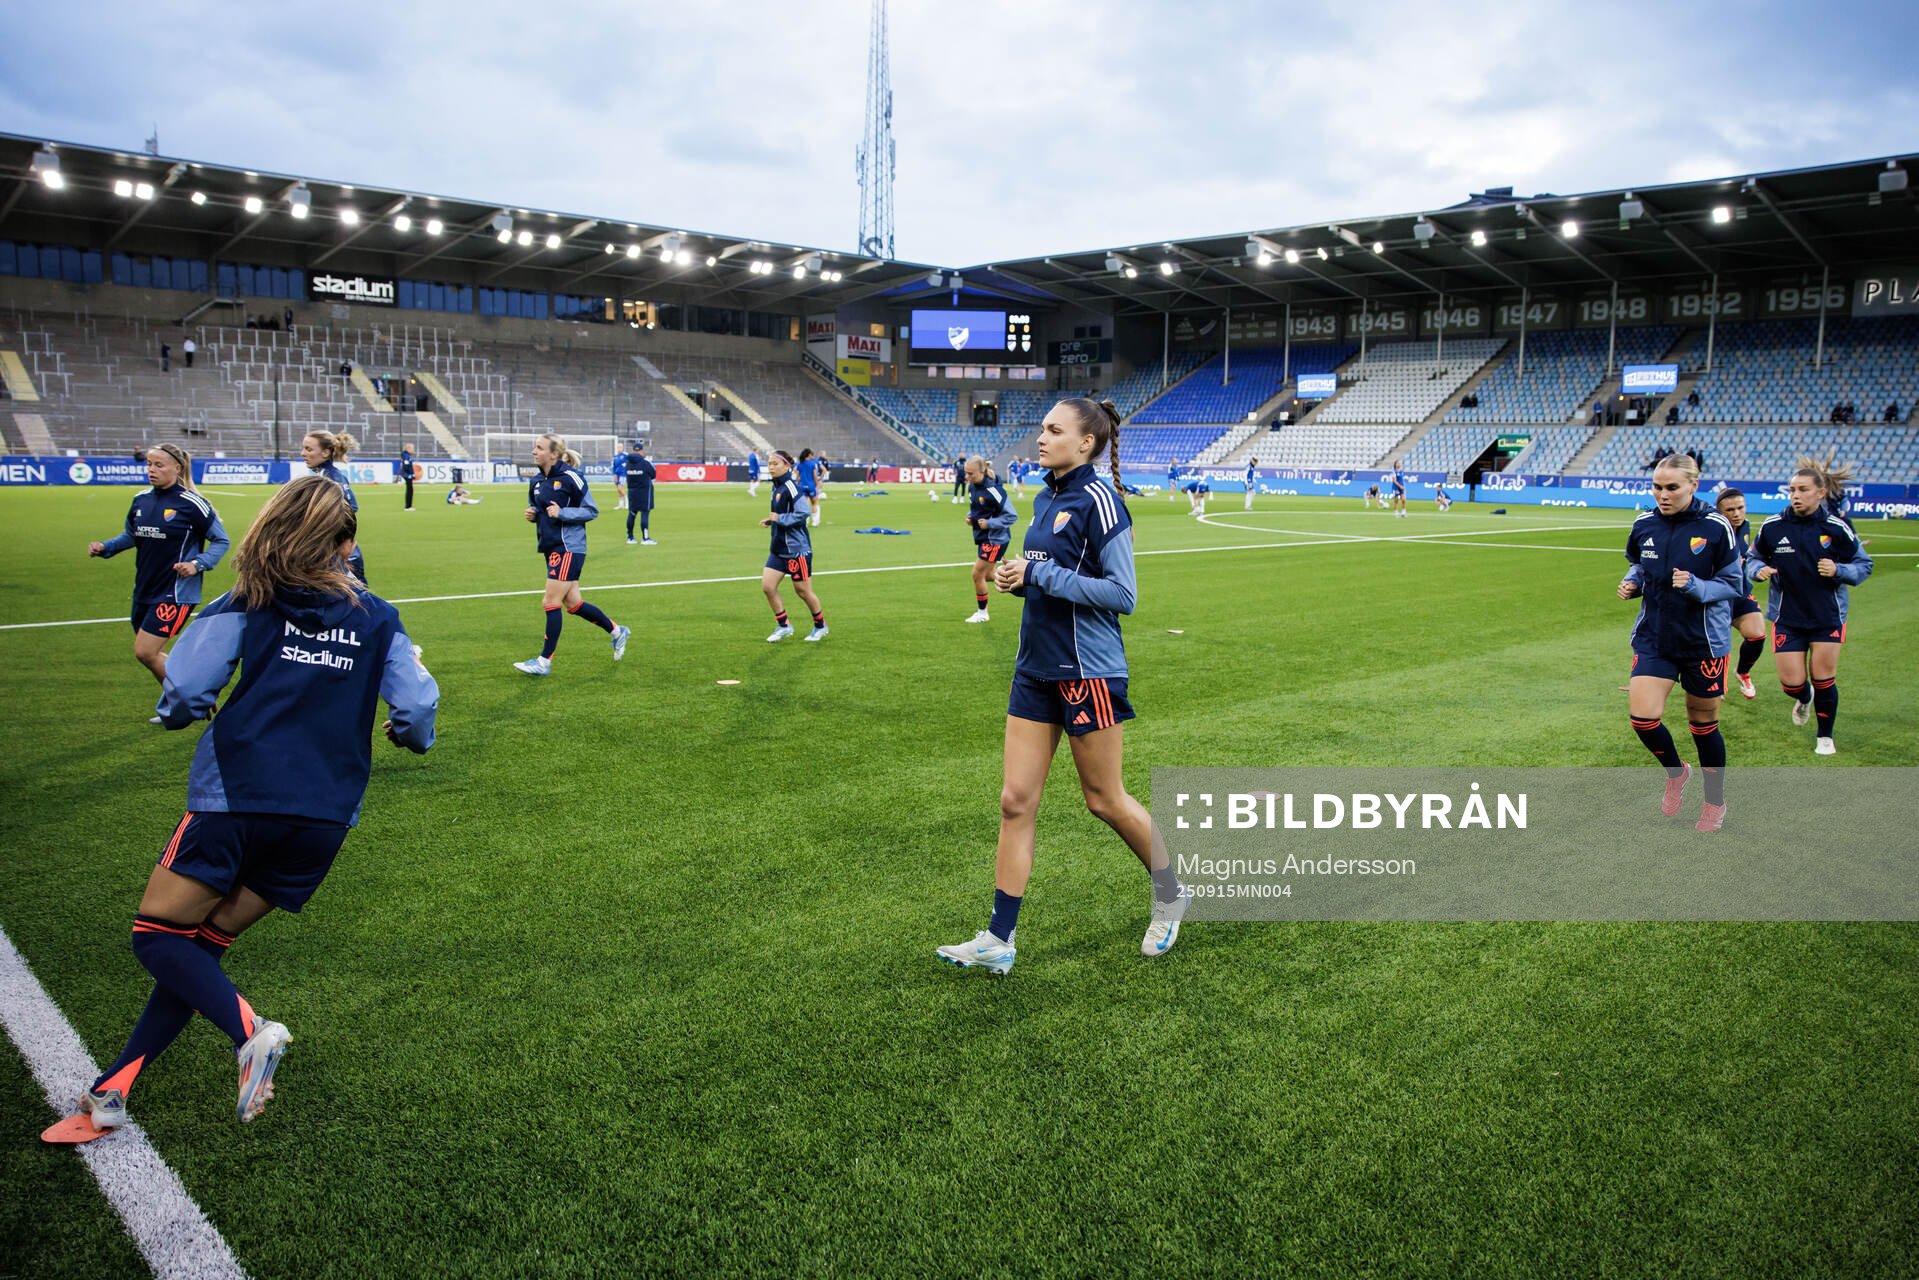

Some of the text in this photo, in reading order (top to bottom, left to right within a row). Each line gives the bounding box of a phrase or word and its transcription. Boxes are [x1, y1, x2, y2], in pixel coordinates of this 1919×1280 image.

[313, 274, 394, 298] stadium
[1580, 297, 1646, 321] 1948
[1670, 291, 1742, 317] 1952
[1765, 285, 1845, 312] 1956
[1349, 311, 1405, 332] 1945
[1424, 307, 1480, 329] 1946
[1500, 303, 1558, 325] 1947
[1288, 316, 1336, 336] 1943
[848, 335, 881, 352] MAXI
[1060, 342, 1081, 352] pre
[1060, 353, 1088, 364] zero
[427, 466, 446, 480] DS
[1581, 479, 1612, 490] EASY
[1853, 502, 1874, 512] IFK
[1024, 550, 1048, 561] NORDIC
[285, 620, 361, 647] MBILL
[281, 645, 354, 671] stadium
